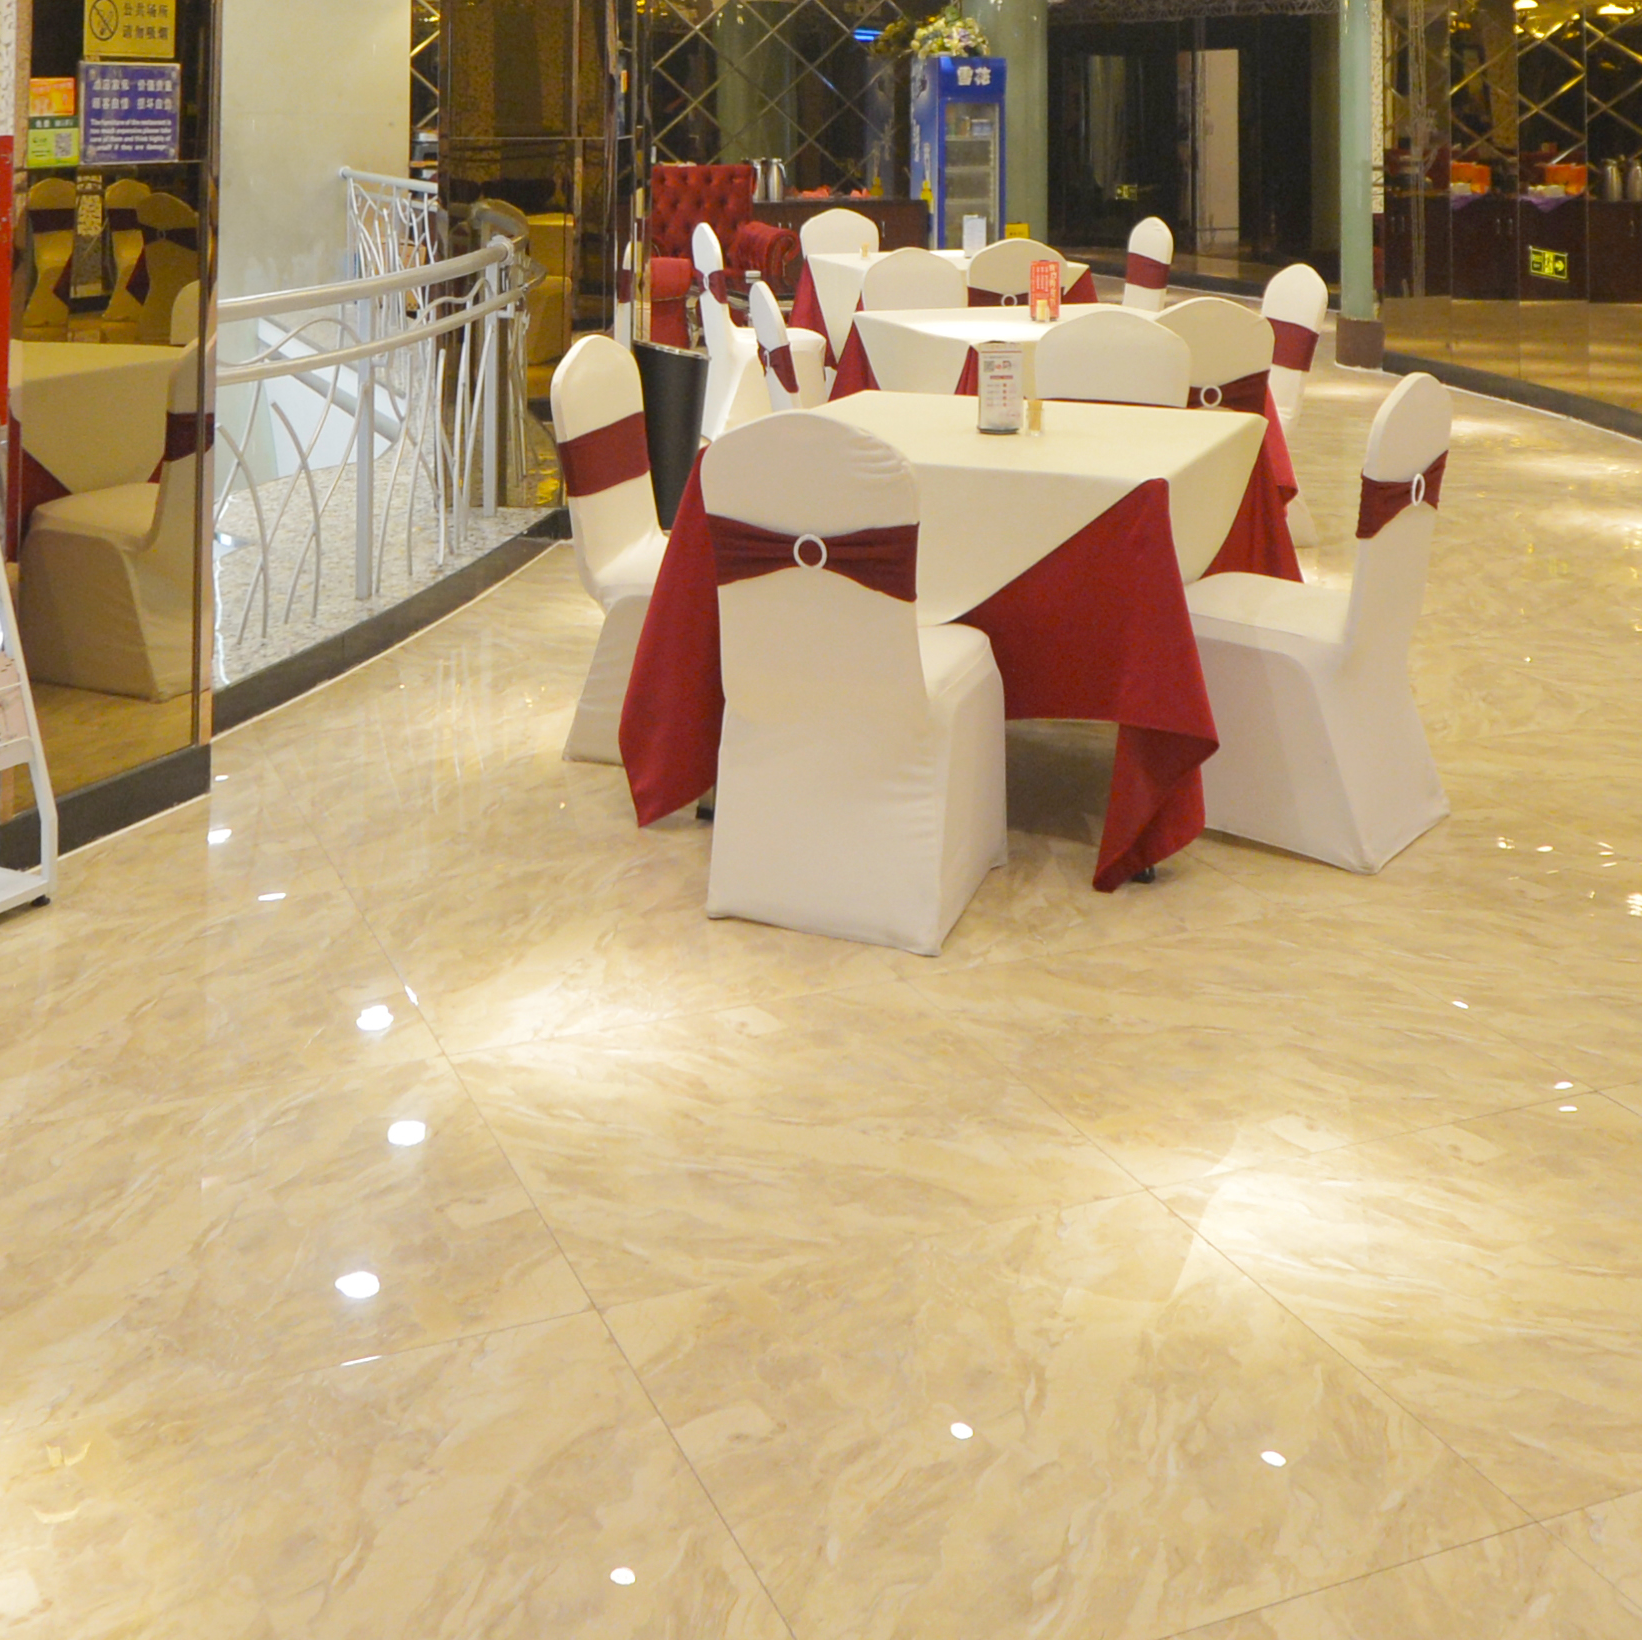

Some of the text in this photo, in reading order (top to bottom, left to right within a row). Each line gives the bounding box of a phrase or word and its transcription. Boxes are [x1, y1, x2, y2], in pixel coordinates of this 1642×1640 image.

[122, 2, 168, 19] 公共场所
[122, 24, 169, 40] 请勿吸烟
[957, 65, 991, 86] 雪花
